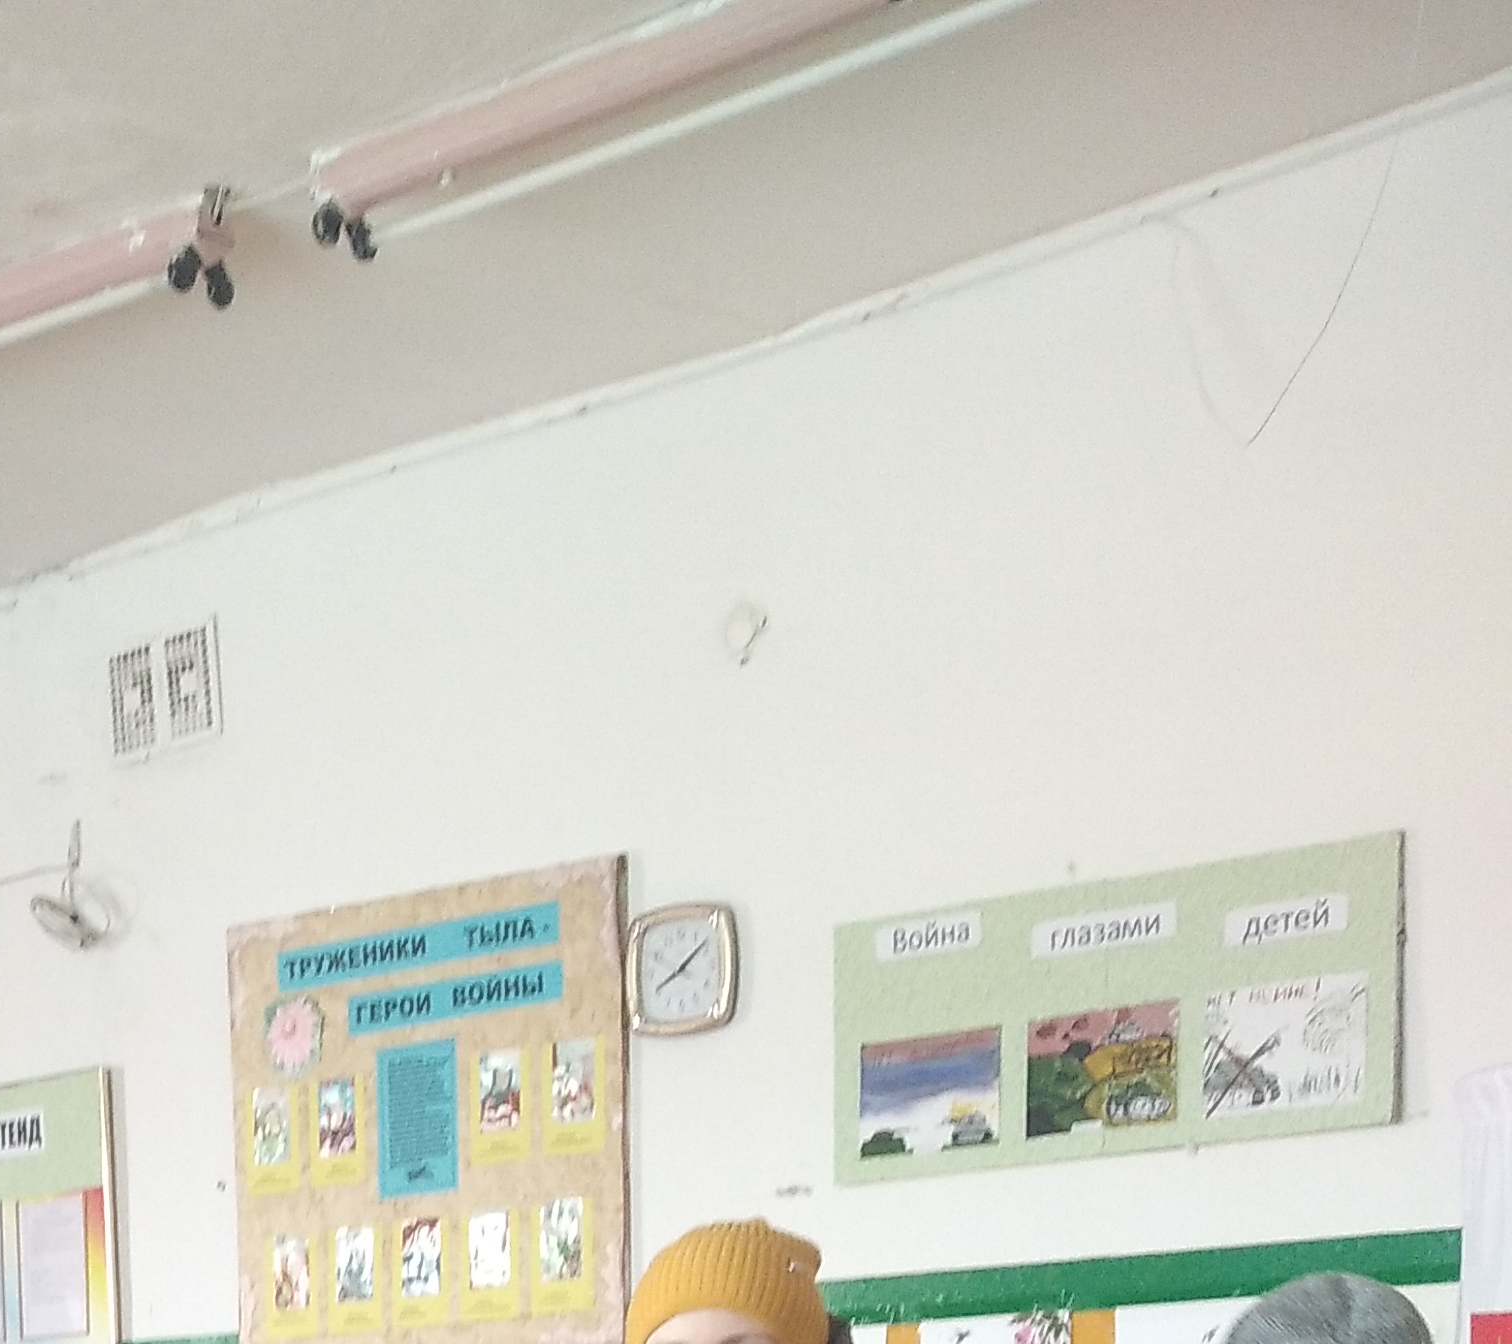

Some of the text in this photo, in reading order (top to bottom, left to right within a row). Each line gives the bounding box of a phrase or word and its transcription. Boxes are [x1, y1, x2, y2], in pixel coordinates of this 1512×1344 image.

[284, 934, 426, 980] ТРУЖЕНИКИ
[464, 916, 534, 949] ТЫЛА
[893, 897, 1330, 954] Война глазами детей
[356, 970, 544, 1025] ГЕРОИ ВОЙНЫ
